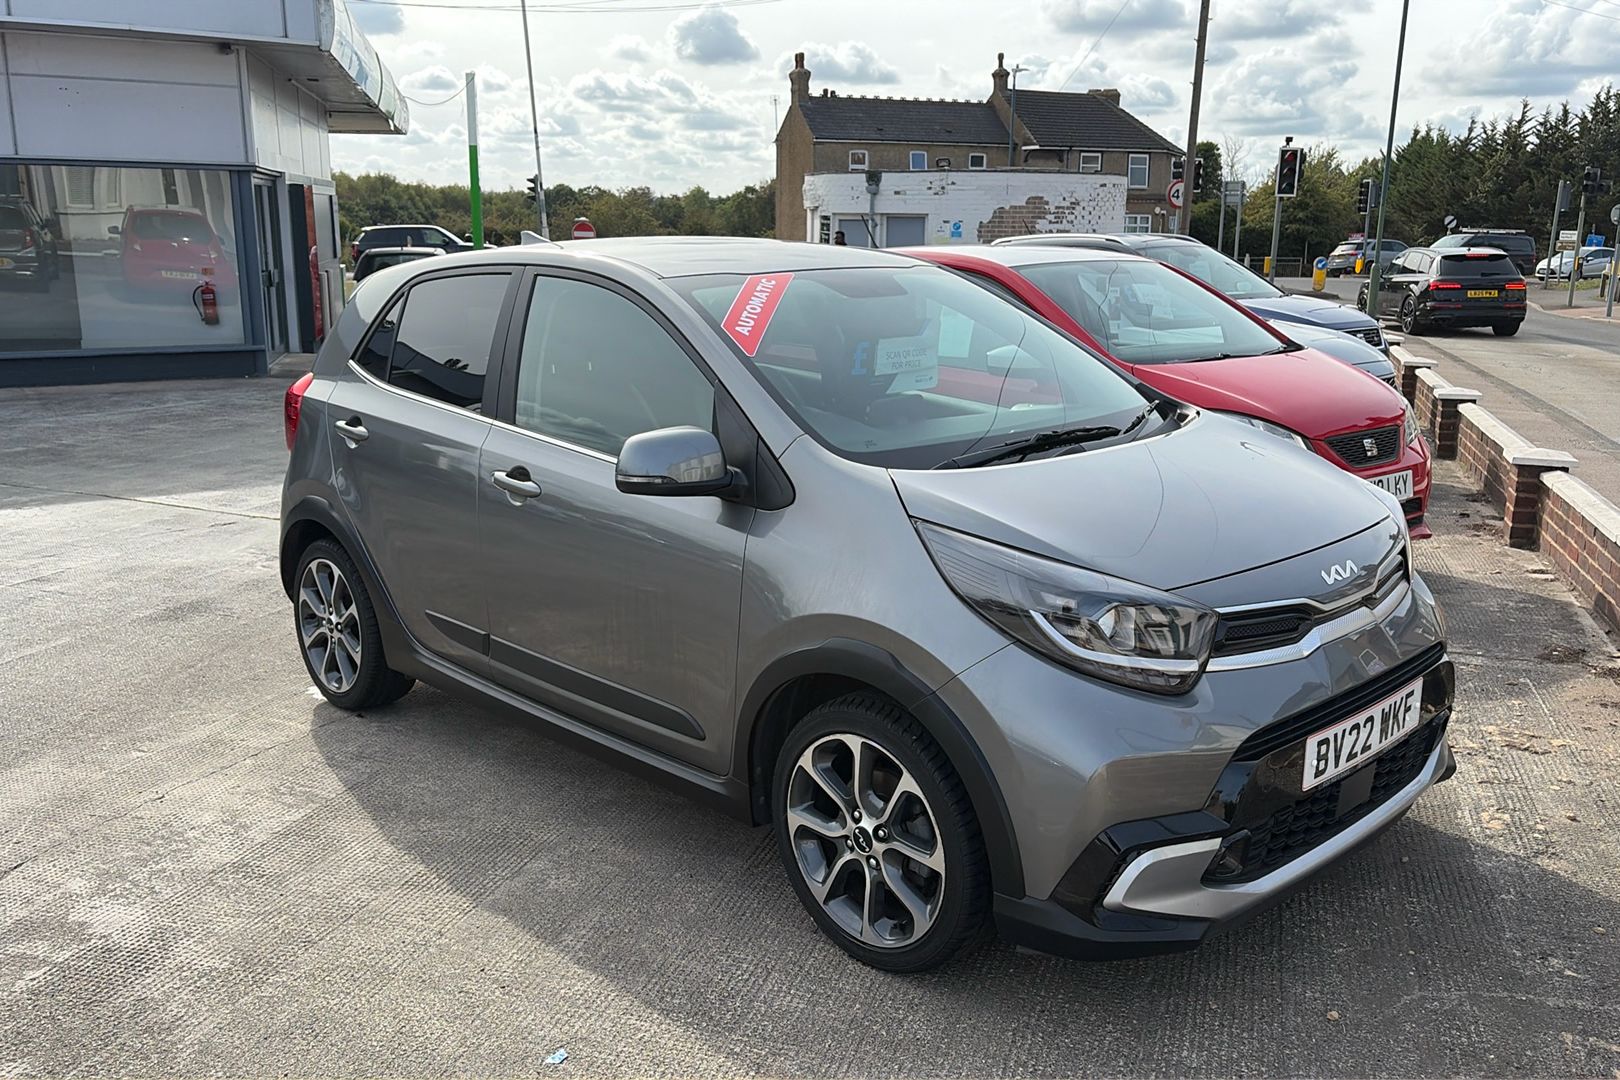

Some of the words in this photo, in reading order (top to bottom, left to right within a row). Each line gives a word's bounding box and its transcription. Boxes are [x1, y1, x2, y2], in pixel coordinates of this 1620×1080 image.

[734, 278, 776, 336] AUTOMATIC
[852, 341, 870, 375] £
[886, 351, 900, 360] SCAN
[891, 361, 904, 370] FOR
[904, 359, 921, 369] PRICE
[1321, 559, 1358, 585] KIA
[1314, 714, 1375, 779] BV22
[1379, 689, 1415, 744] WKF
